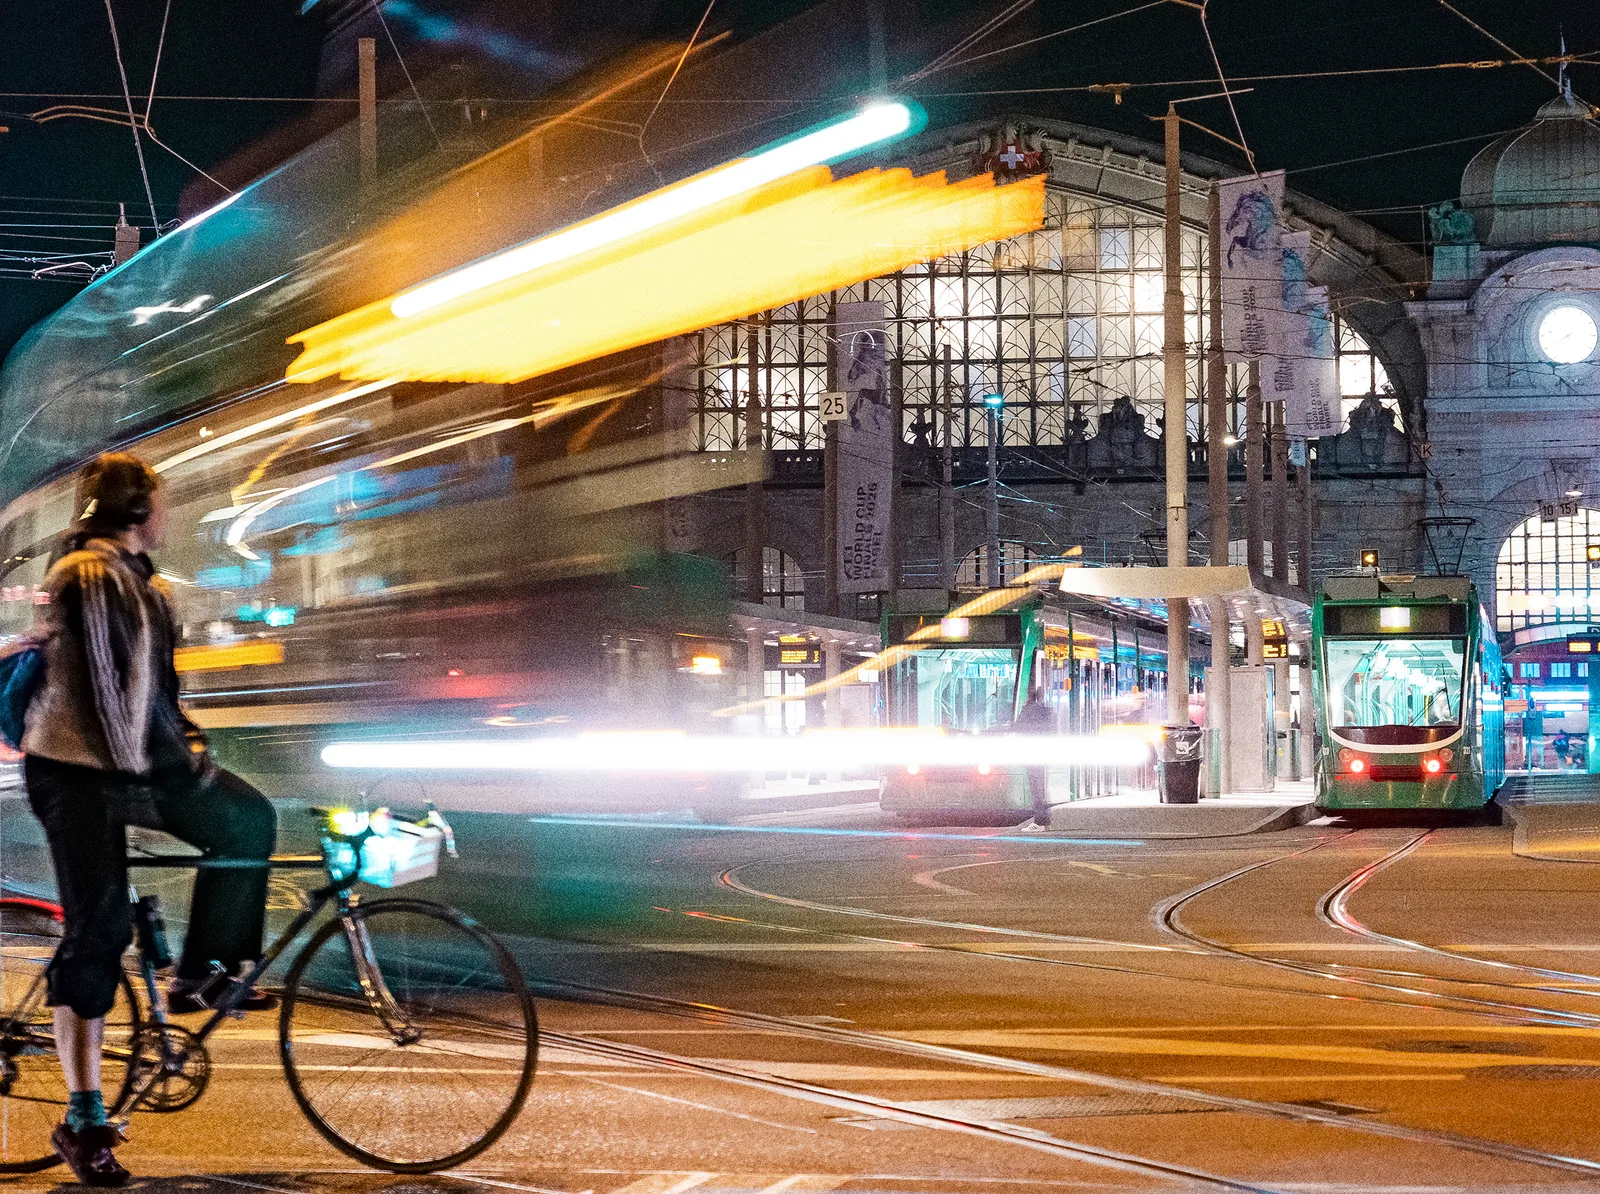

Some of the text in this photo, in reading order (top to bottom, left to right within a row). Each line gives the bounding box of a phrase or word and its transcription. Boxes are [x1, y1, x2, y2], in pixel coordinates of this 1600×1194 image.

[823, 397, 844, 415] 25
[1422, 444, 1433, 457] K
[1543, 505, 1553, 516] 10
[853, 486, 866, 581] WORLD CUP
[863, 482, 878, 580] FINALS 2026
